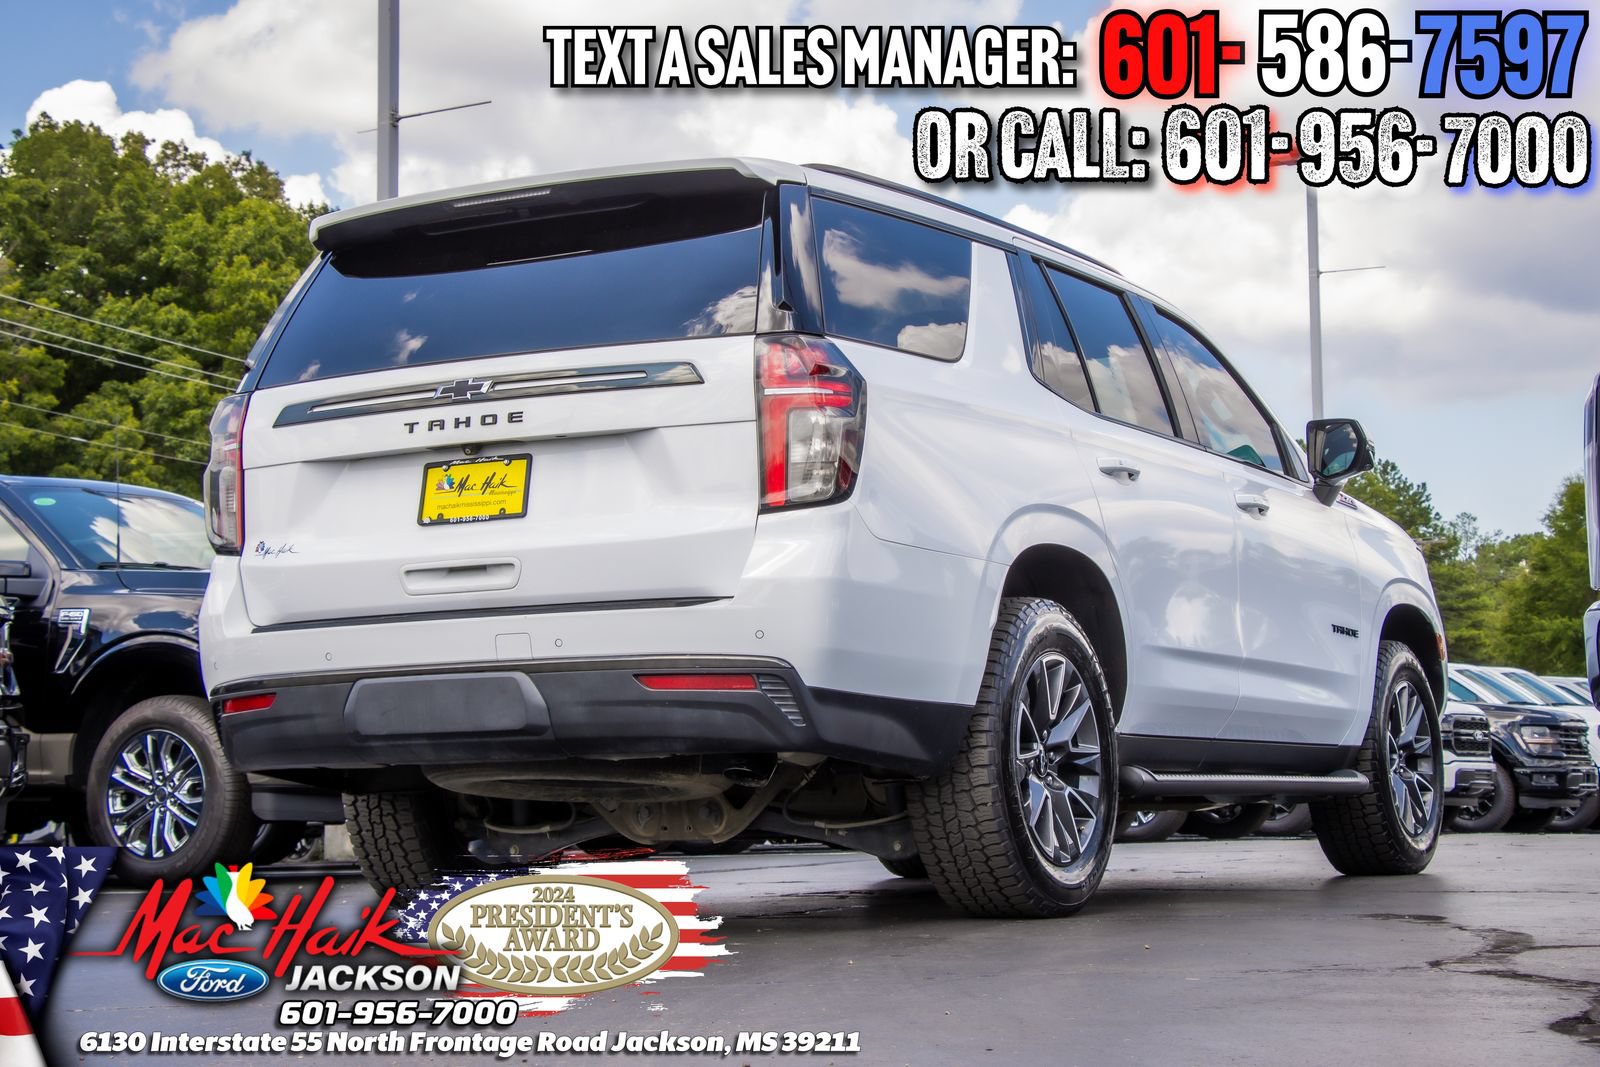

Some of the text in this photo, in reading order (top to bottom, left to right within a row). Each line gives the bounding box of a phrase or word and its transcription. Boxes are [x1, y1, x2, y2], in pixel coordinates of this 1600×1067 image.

[404, 411, 524, 434] TAHOE
[452, 472, 517, 497] Mac Haik
